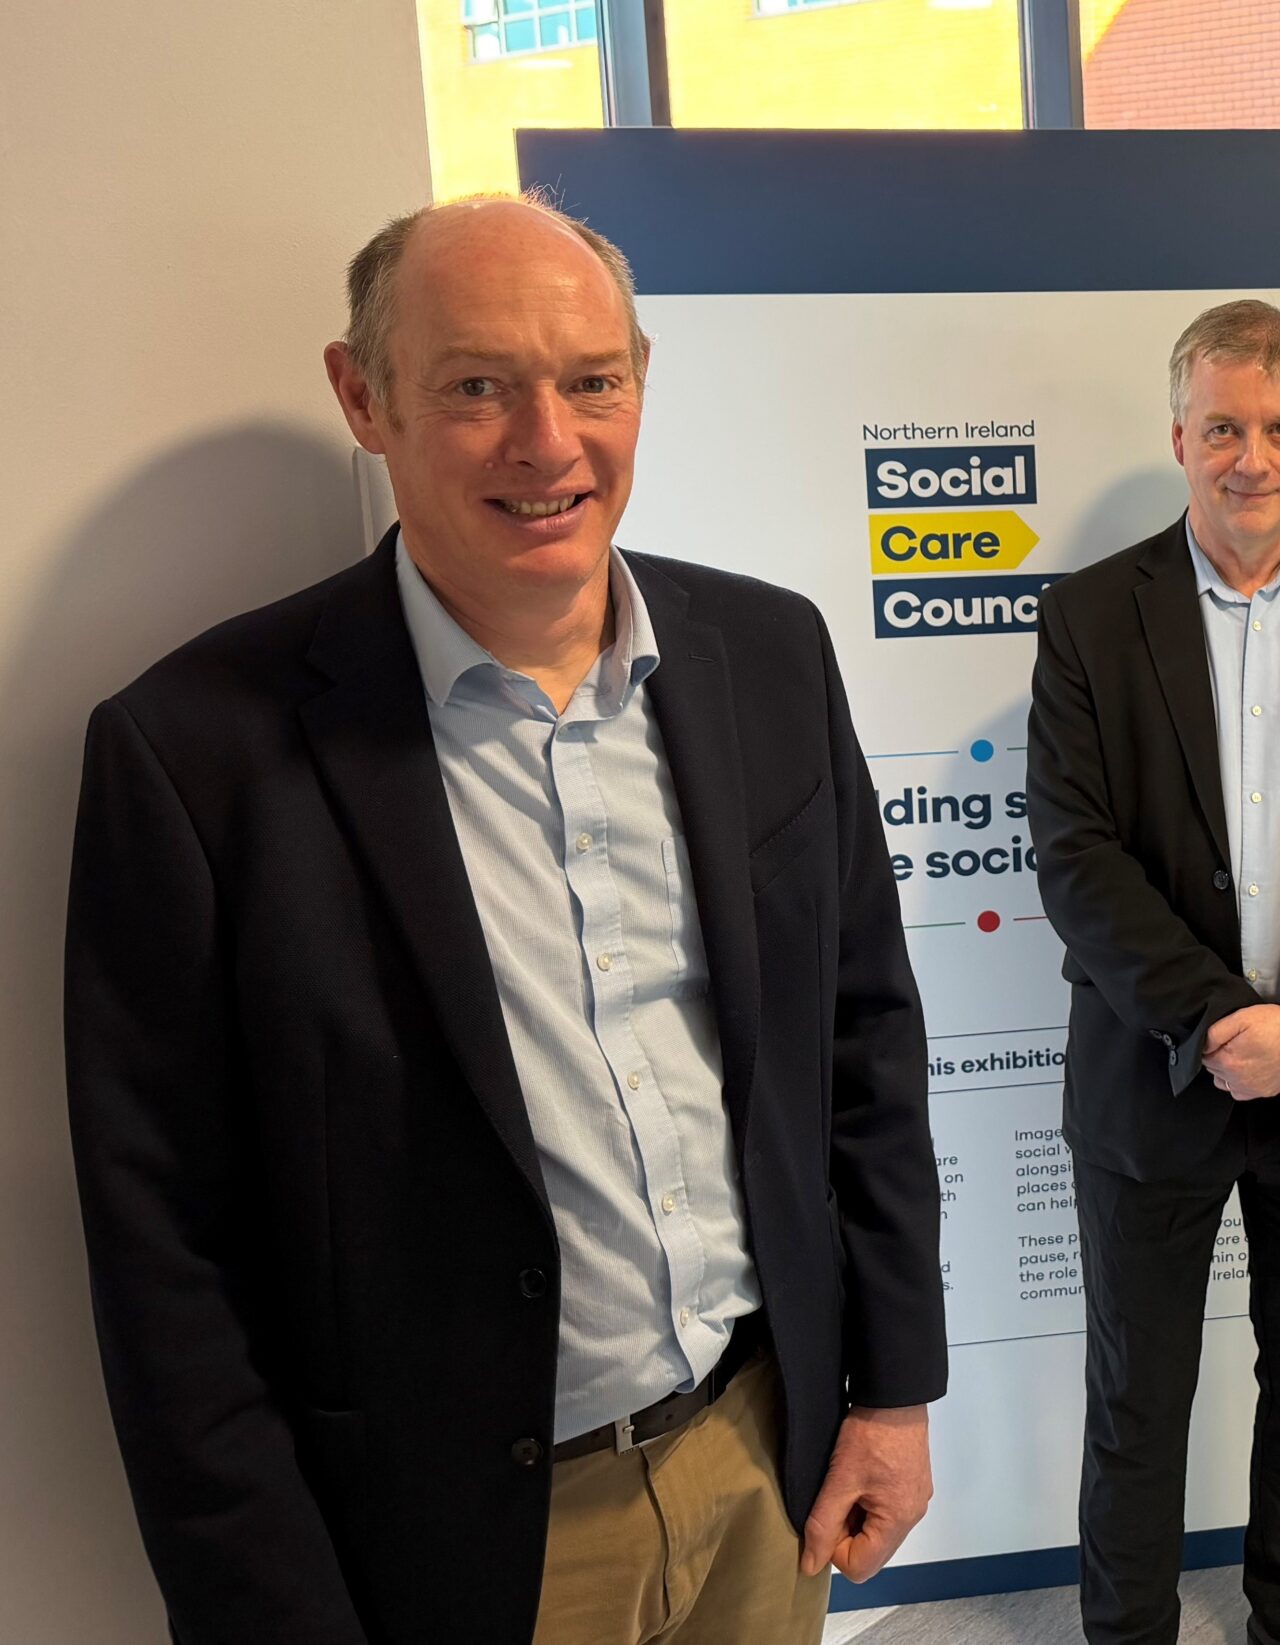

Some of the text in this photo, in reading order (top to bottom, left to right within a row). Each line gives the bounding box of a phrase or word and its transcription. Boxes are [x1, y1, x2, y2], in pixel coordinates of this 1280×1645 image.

[863, 419, 1035, 440] Northern Ireland
[876, 455, 1026, 499] Social
[880, 525, 1000, 562] Care
[883, 583, 1050, 628] Counc
[875, 785, 992, 830] ding
[961, 1047, 1066, 1074] exhibitio
[1015, 1128, 1063, 1142] Image
[1015, 1143, 1060, 1159] social
[1016, 1160, 1071, 1177] alongsi
[944, 1173, 964, 1183] on
[1017, 1181, 1067, 1197] places
[1017, 1201, 1046, 1212] can
[1018, 1234, 1064, 1247] These
[1221, 1218, 1241, 1227] ou
[1019, 1252, 1069, 1268] pause,
[1019, 1270, 1045, 1282] the
[1049, 1266, 1078, 1279] role
